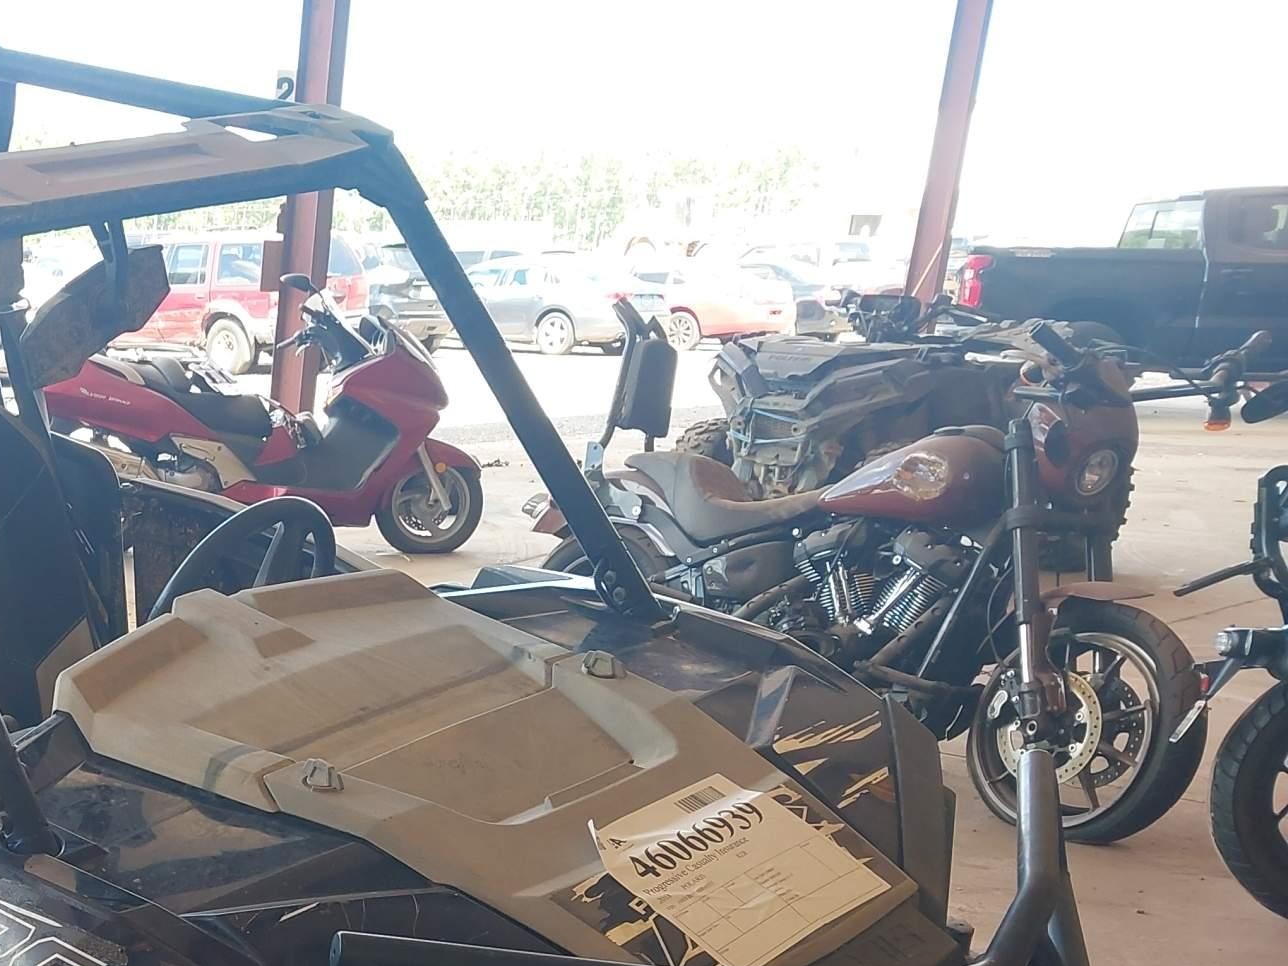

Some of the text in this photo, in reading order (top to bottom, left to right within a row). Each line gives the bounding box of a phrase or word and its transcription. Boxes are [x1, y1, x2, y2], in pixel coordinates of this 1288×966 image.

[276, 76, 295, 100] 2
[629, 802, 763, 878] 46066939
[642, 868, 689, 897] Progressive
[685, 852, 720, 875] Casualty
[715, 836, 750, 858] Insurance
